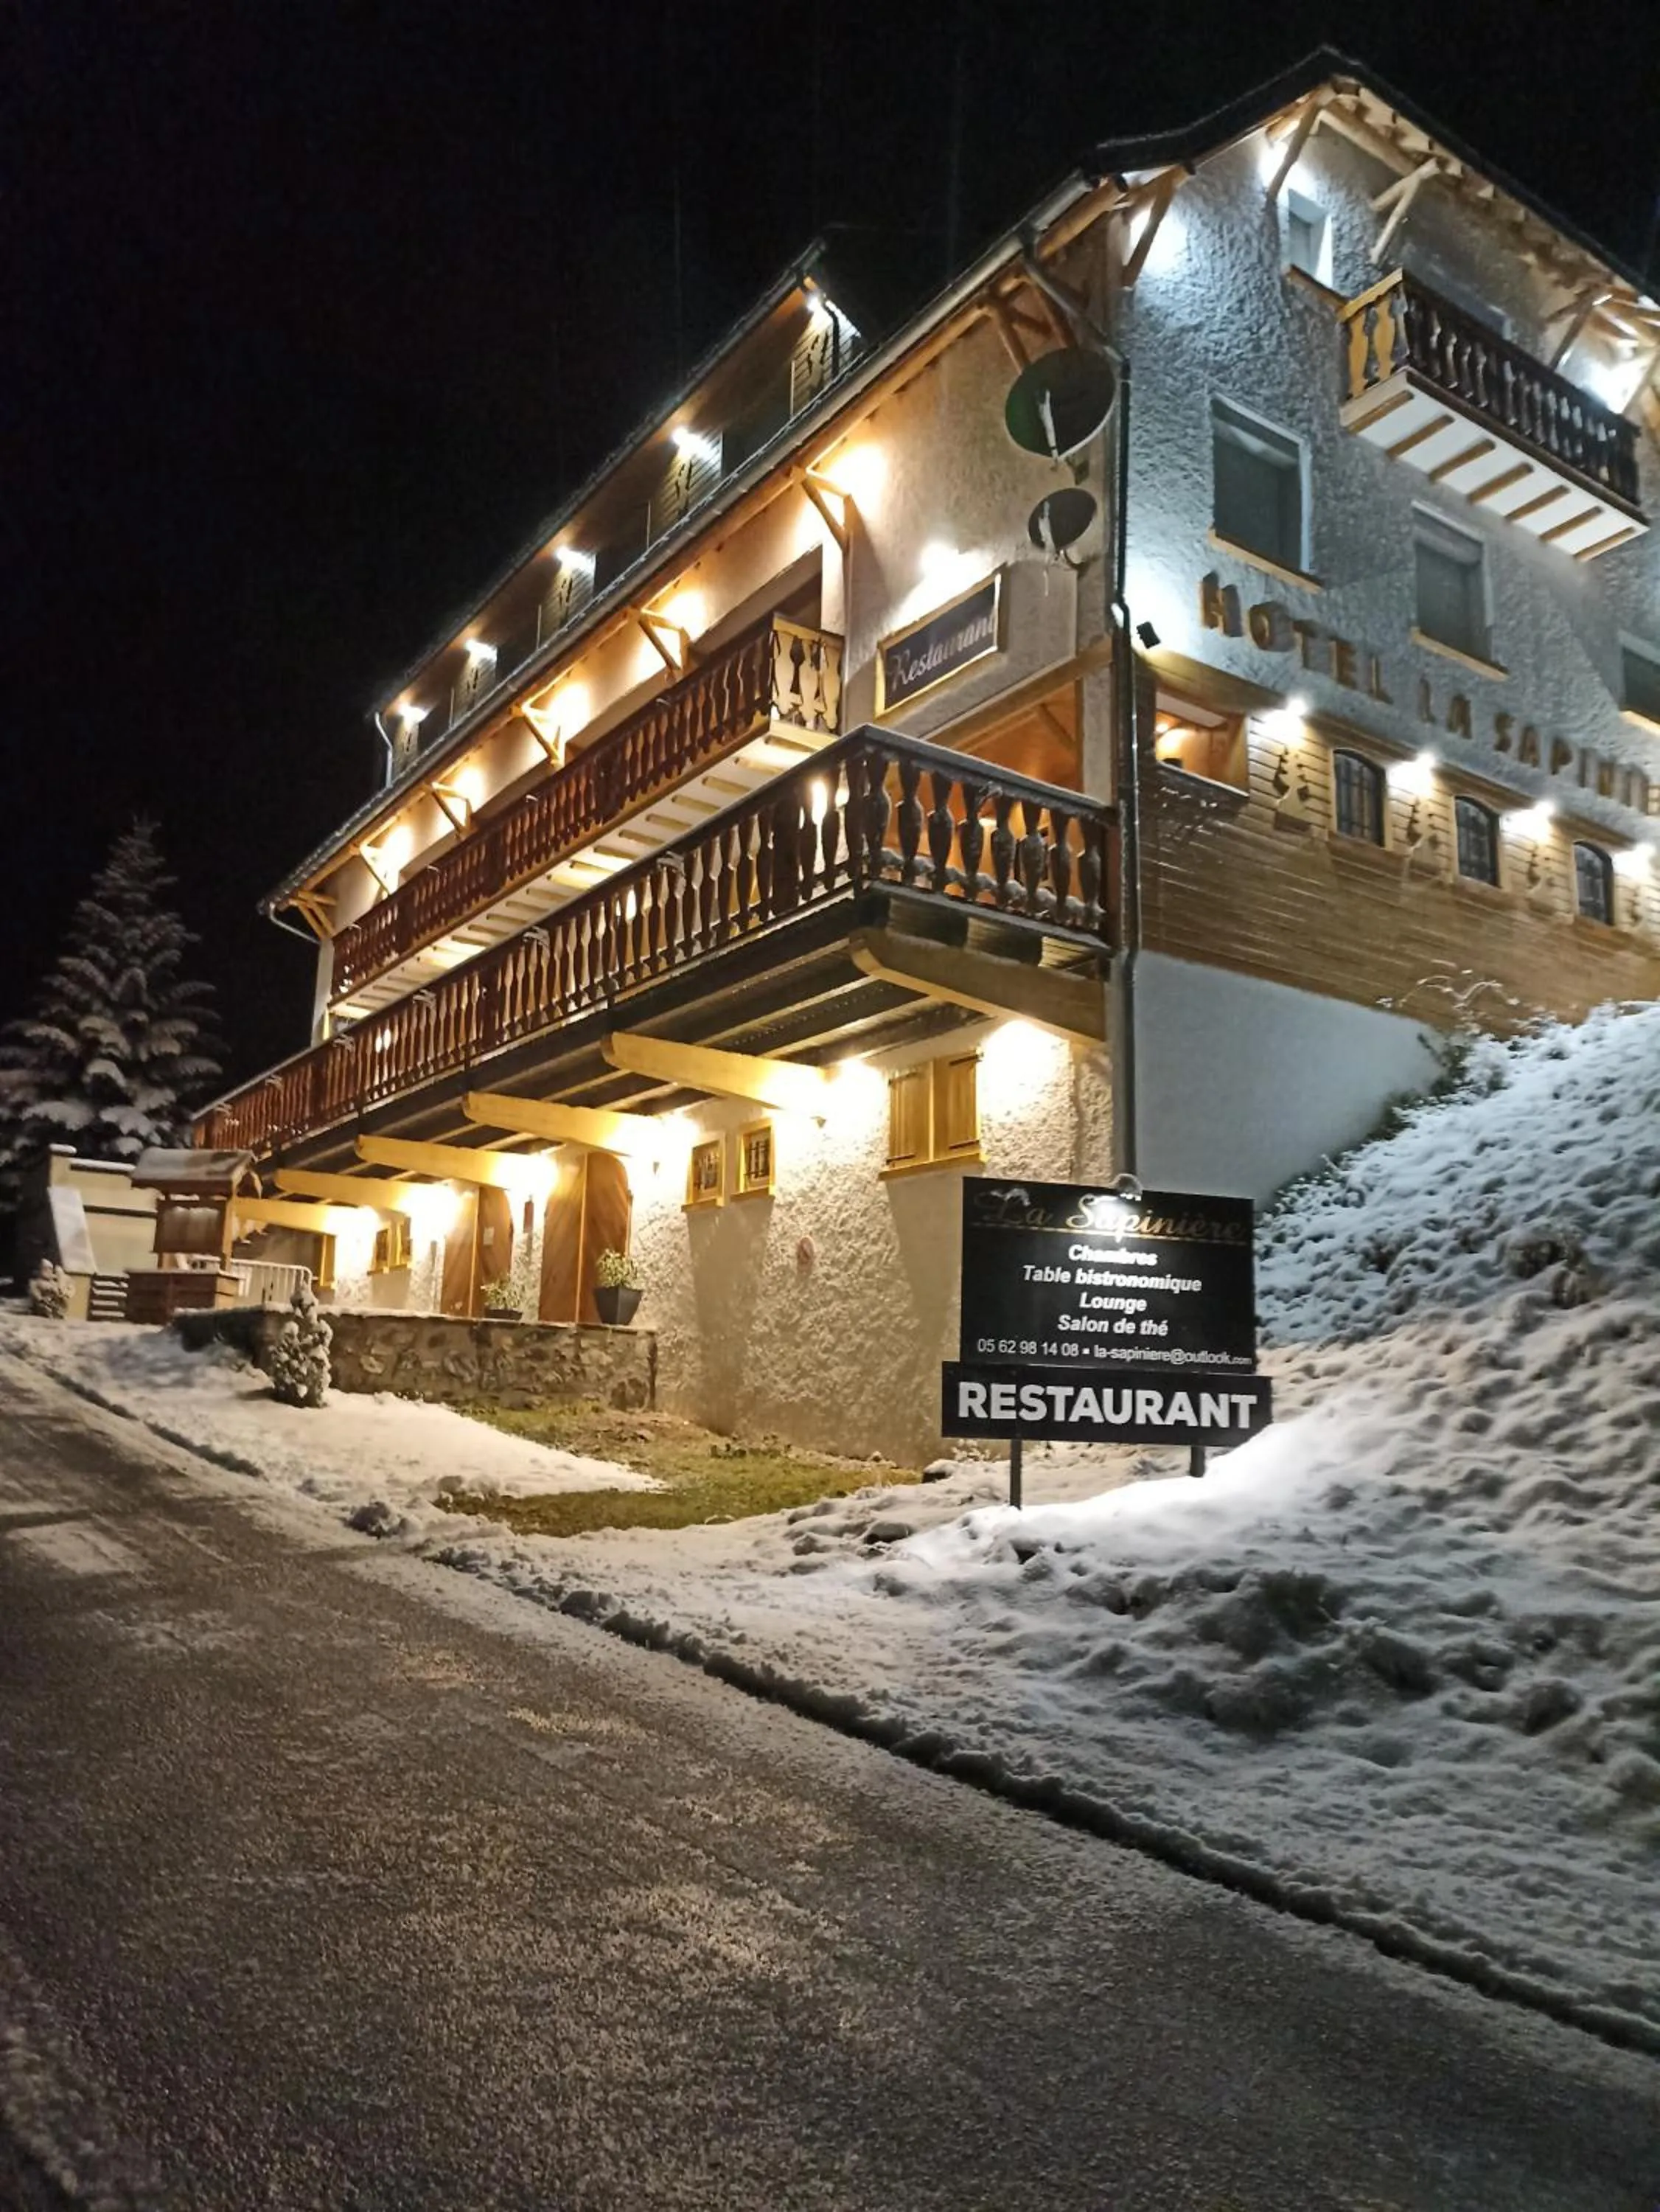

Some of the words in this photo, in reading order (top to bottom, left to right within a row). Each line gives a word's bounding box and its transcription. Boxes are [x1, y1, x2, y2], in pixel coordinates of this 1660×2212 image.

[1200, 571, 1393, 704] HOTEL
[1068, 1244, 1158, 1266] Chambres
[1023, 1265, 1071, 1284] Table
[1075, 1267, 1202, 1293] bistronomique
[1079, 1292, 1147, 1314] Lounge
[1057, 1315, 1109, 1333] Salon
[1113, 1318, 1136, 1335] de
[1140, 1318, 1169, 1336] thé
[977, 1338, 995, 1353] 05
[999, 1340, 1016, 1354] 62
[1042, 1342, 1058, 1356] 14
[1061, 1343, 1080, 1358] 08
[958, 1381, 1258, 1429] RESTAURANT
